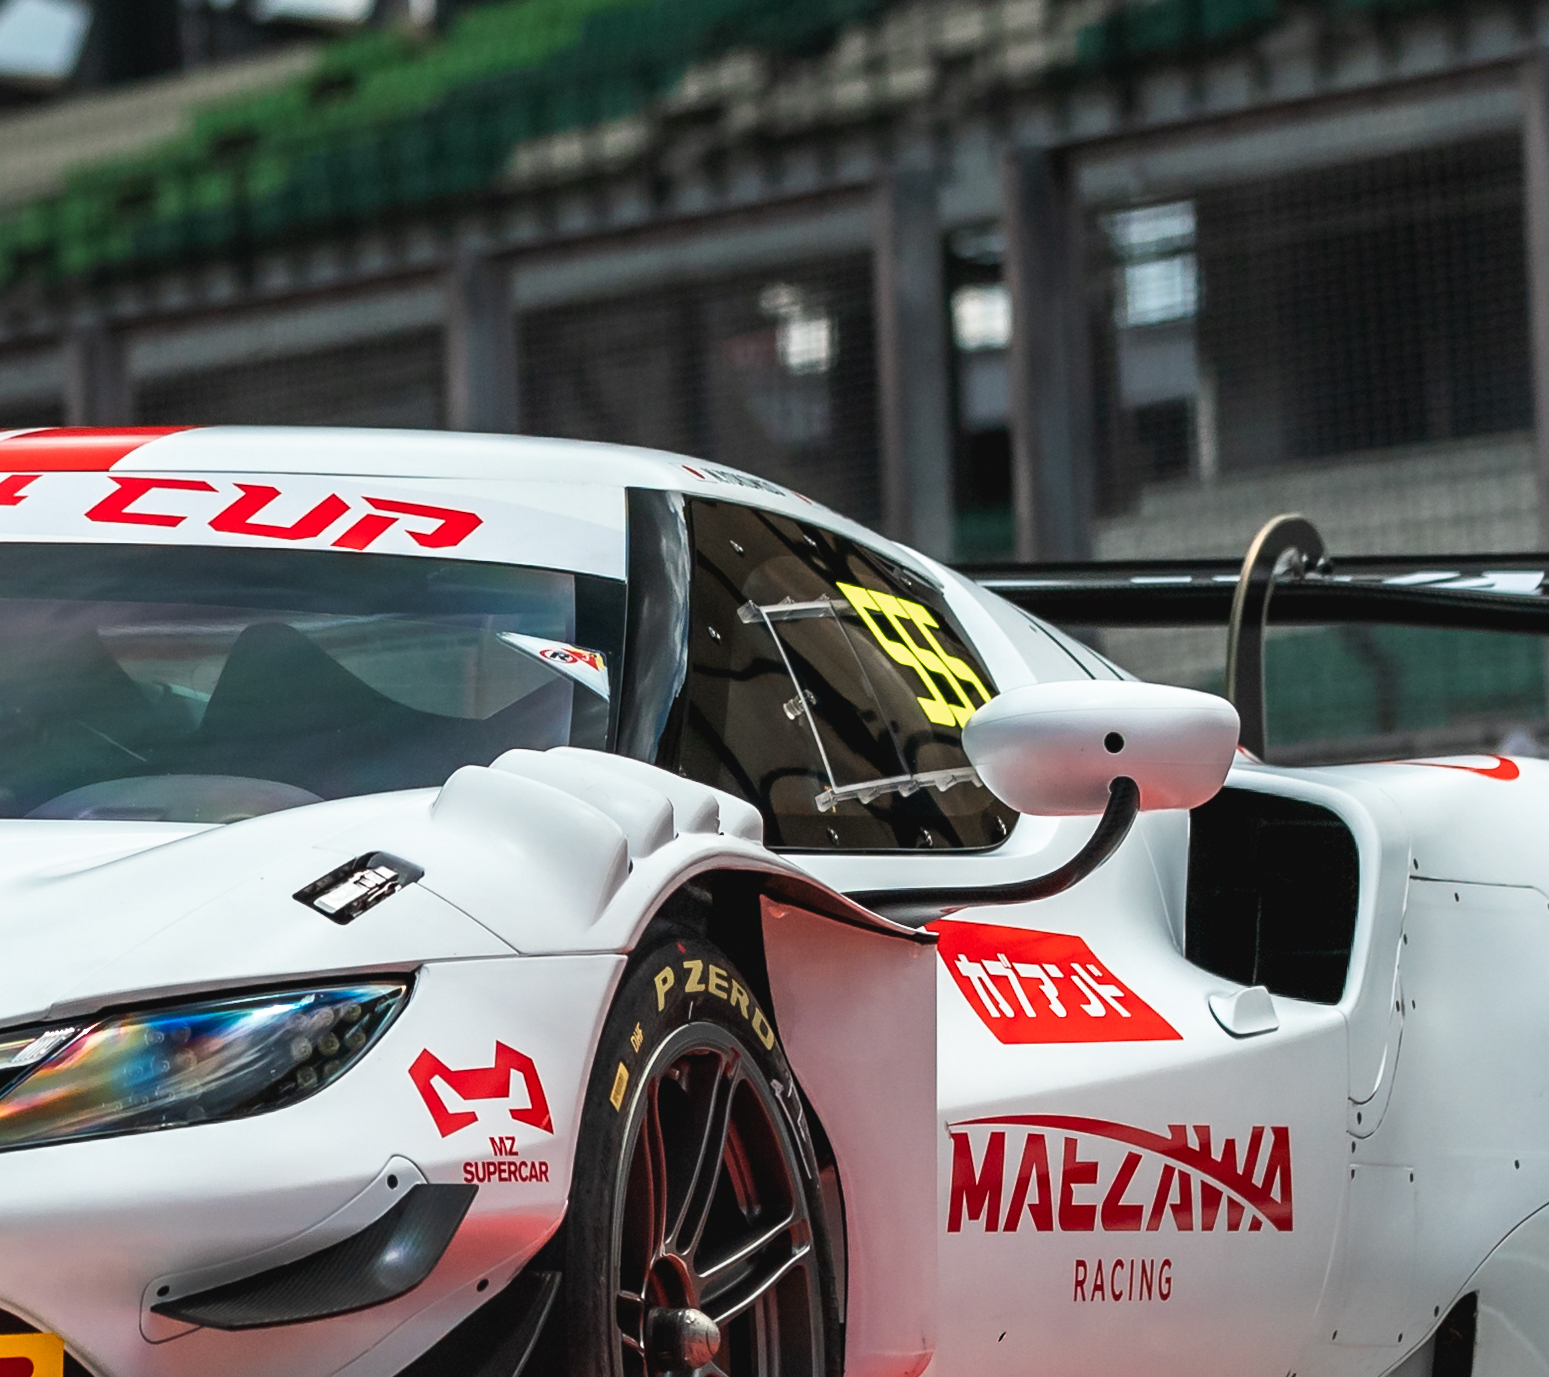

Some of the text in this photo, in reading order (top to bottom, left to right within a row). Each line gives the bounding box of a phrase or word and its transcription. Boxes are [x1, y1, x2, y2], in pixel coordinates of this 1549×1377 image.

[85, 477, 483, 551] CUP
[654, 959, 775, 1051] P ZERO
[954, 953, 1132, 1018] カブアンド
[463, 1161, 549, 1183] SUPERCAR
[489, 1136, 519, 1157] MZ
[947, 1114, 1294, 1233] MAEZAWA
[1073, 1258, 1174, 1302] RACING
